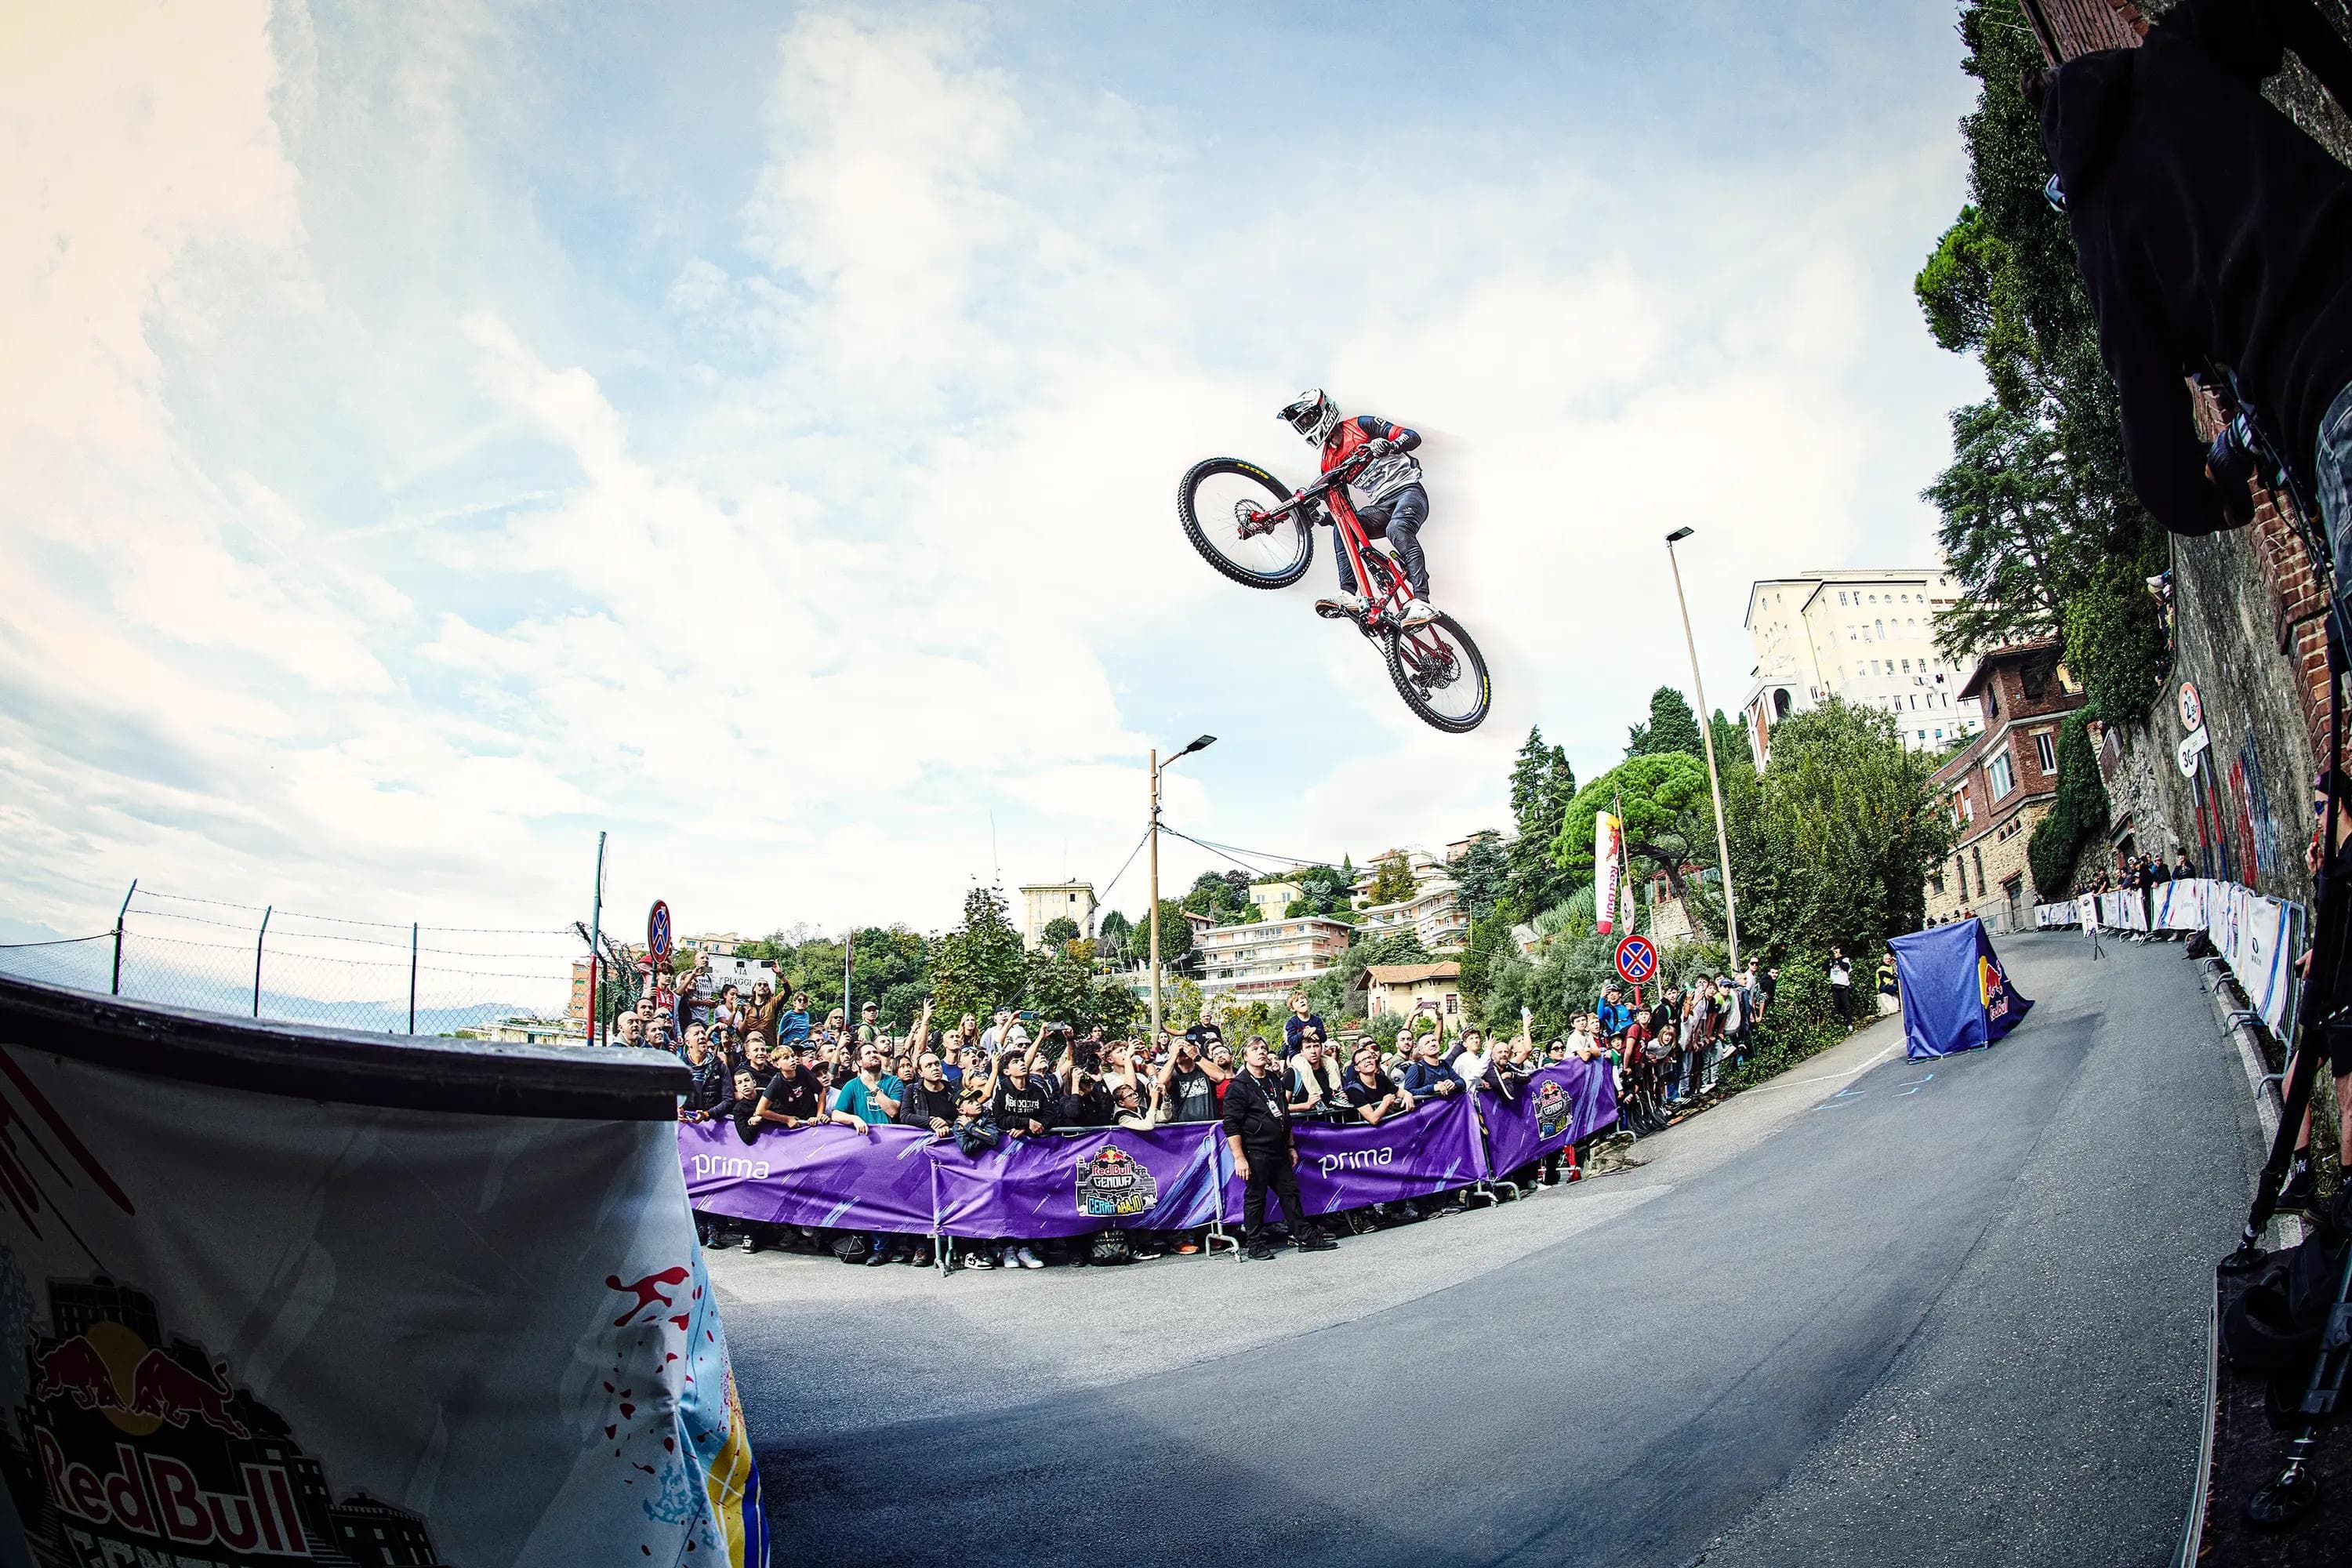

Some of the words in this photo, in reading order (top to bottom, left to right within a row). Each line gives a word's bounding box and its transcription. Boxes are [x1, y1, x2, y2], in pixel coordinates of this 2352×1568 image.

[734, 967, 747, 976] VIA
[724, 977, 752, 986] PIAGGI
[691, 1153, 770, 1180] prima
[1092, 1163, 1111, 1175] Red
[1112, 1163, 1131, 1175] Bull
[1318, 1147, 1392, 1179] prima
[1093, 1176, 1132, 1188] GENOVA
[1116, 1194, 1142, 1214] ABAJO
[34, 1425, 161, 1537] Red
[144, 1453, 314, 1557] Bull
